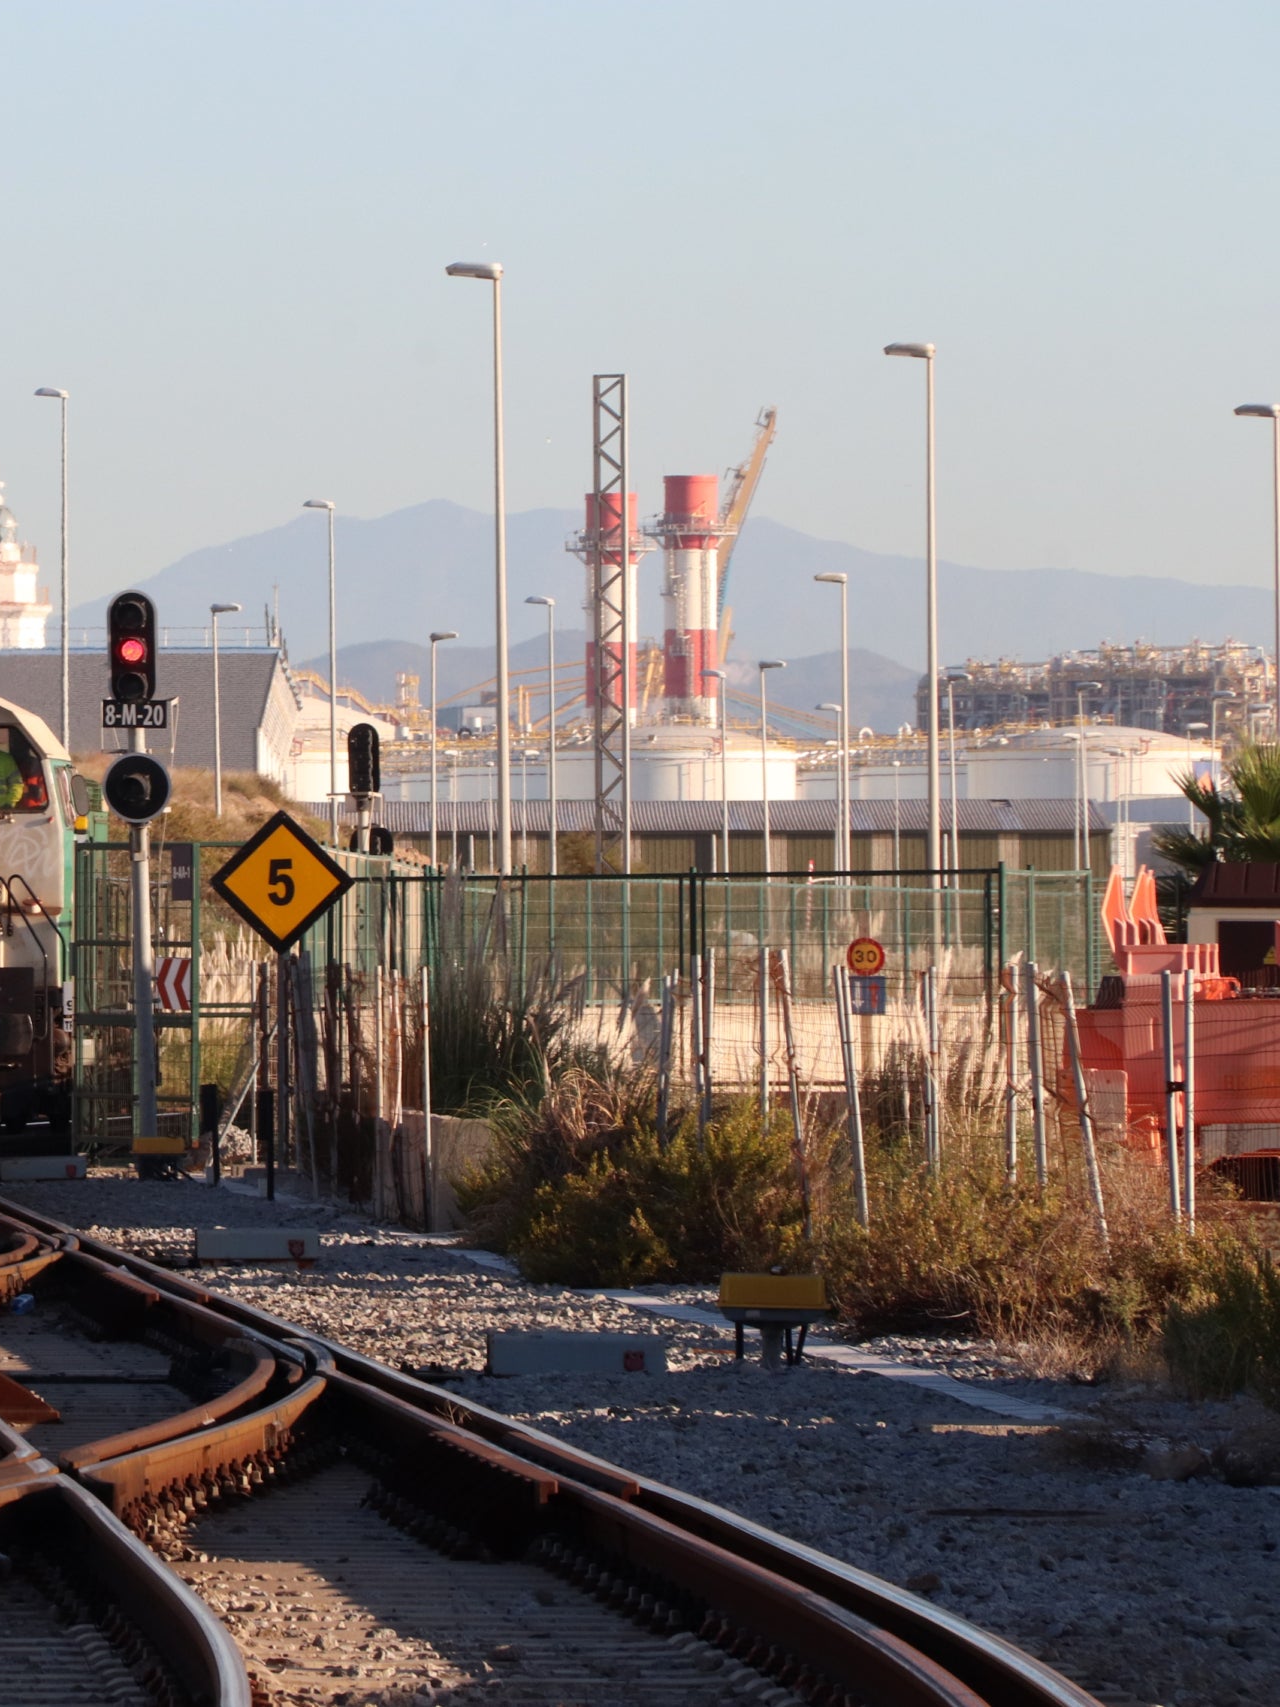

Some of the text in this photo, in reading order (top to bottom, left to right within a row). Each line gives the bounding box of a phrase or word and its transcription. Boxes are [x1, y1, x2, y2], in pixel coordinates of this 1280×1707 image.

[105, 703, 164, 726] 8-M-20
[268, 858, 295, 907] 5
[854, 950, 877, 963] 30
